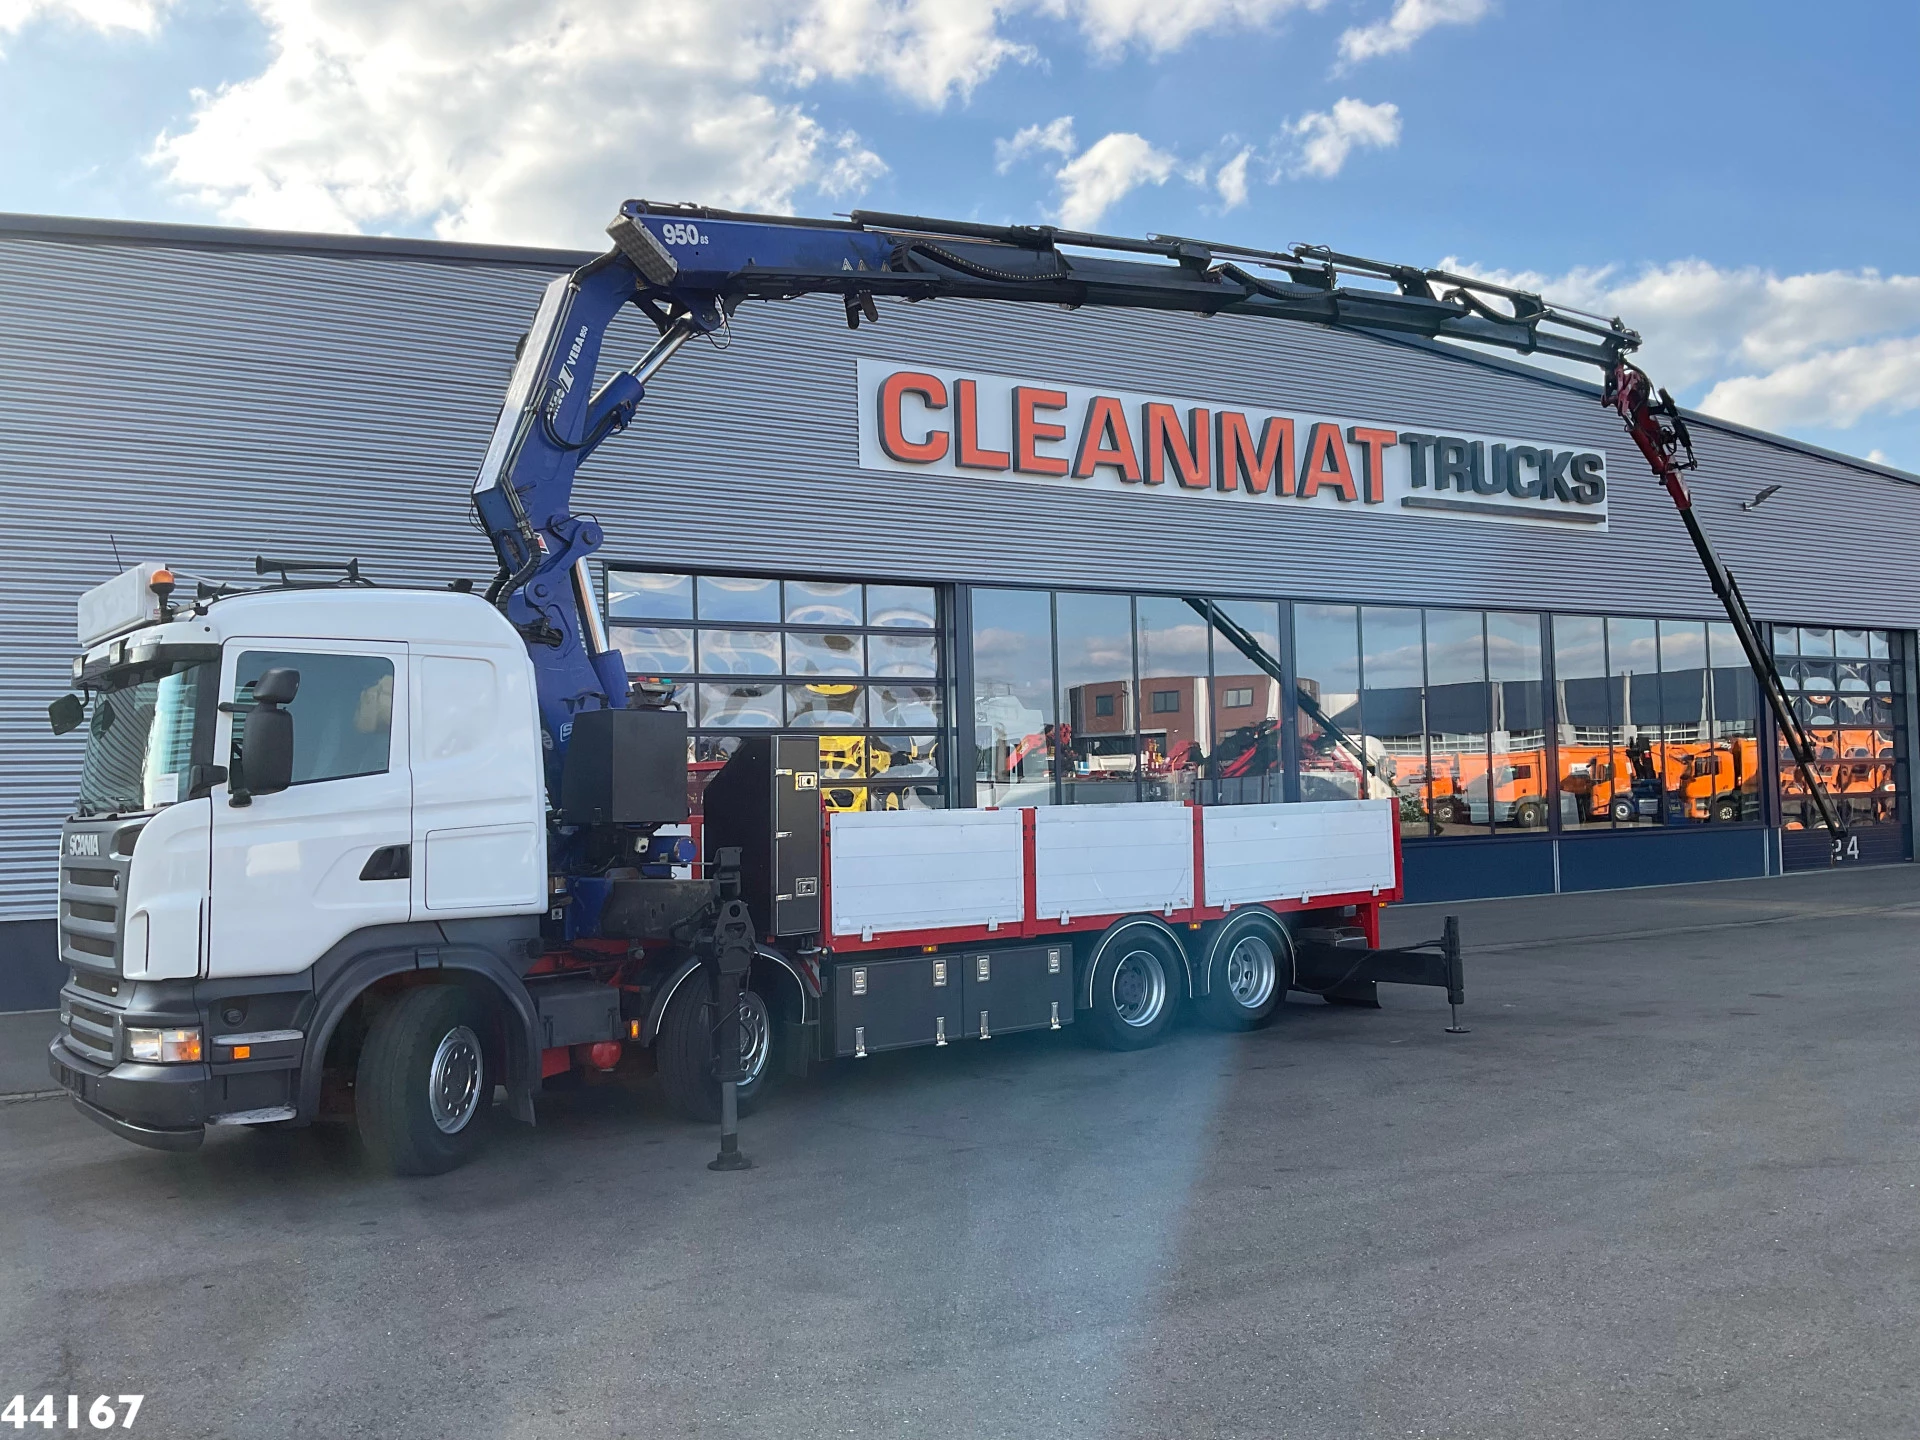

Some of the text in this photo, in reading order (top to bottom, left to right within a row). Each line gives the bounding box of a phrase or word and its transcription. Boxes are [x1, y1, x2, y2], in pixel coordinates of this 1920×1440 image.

[662, 223, 699, 245] 950
[566, 336, 585, 366] VEBA
[877, 371, 1606, 505] CLEANMAT TRUCKS
[69, 834, 100, 856] SCANIA
